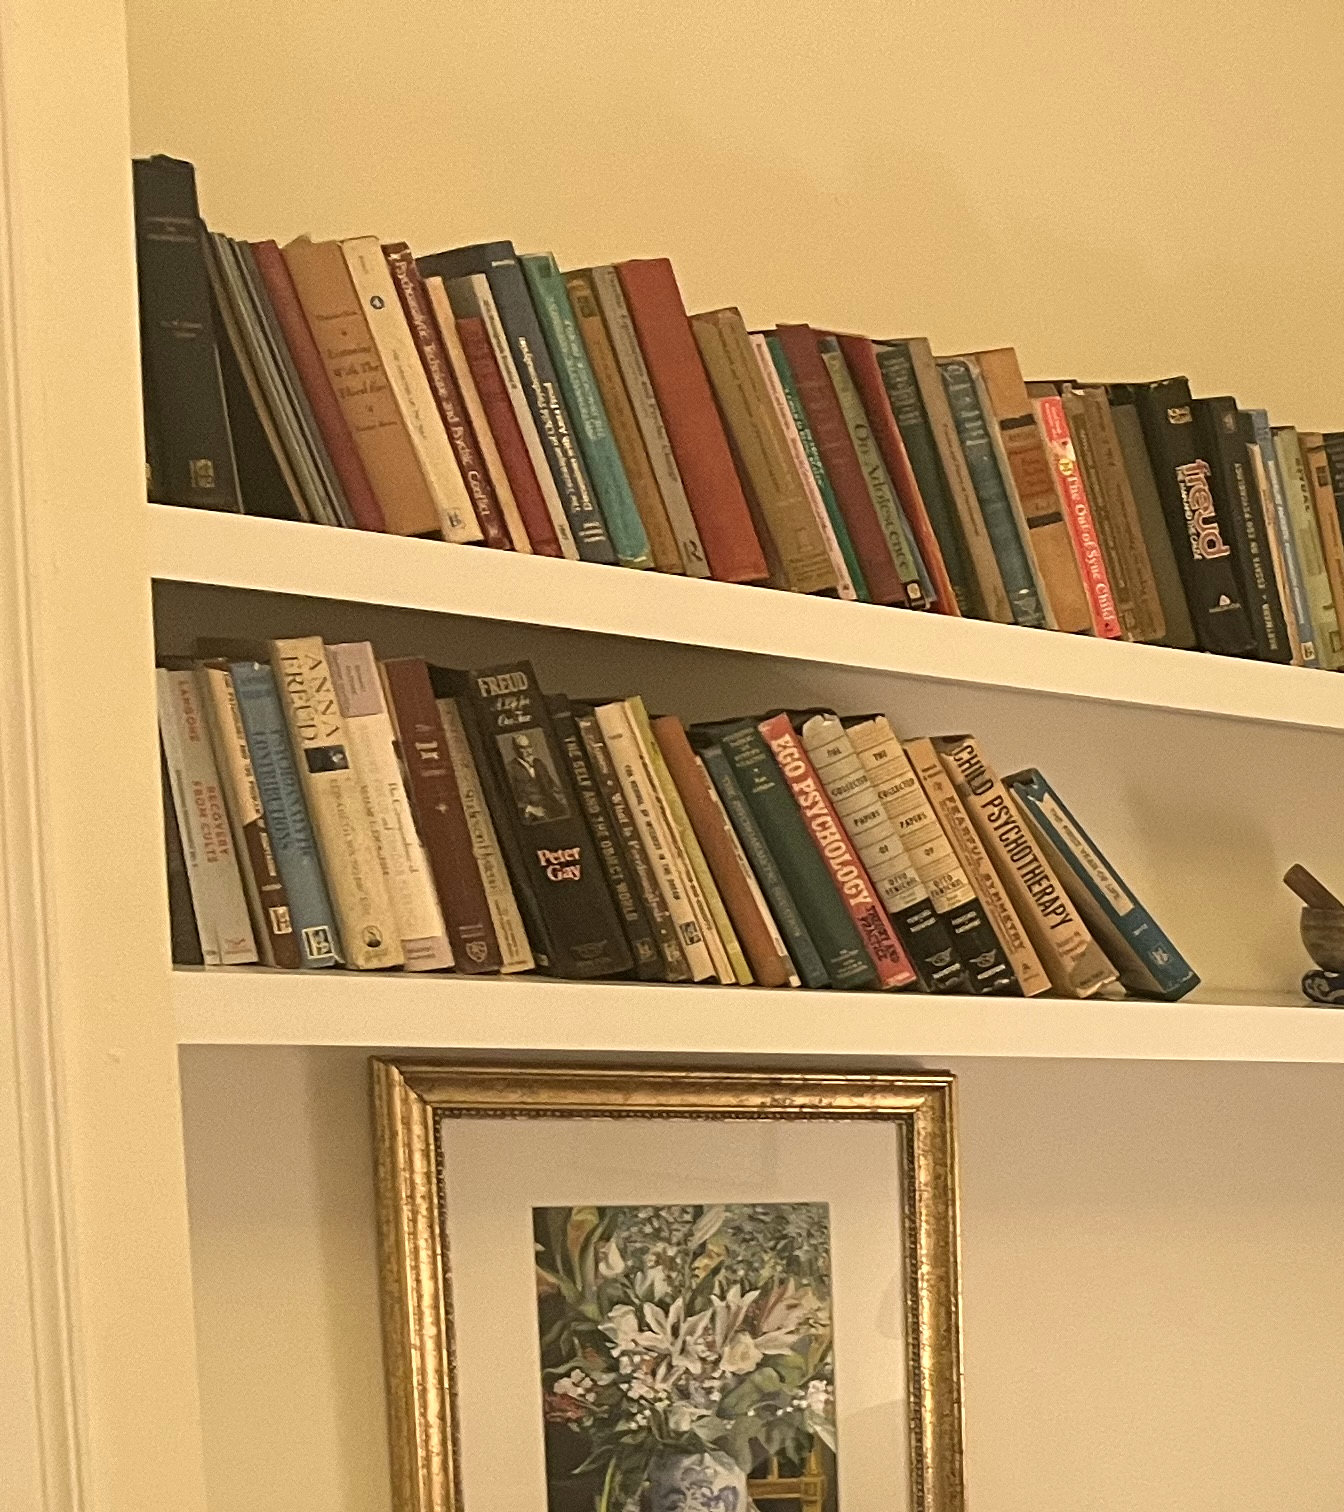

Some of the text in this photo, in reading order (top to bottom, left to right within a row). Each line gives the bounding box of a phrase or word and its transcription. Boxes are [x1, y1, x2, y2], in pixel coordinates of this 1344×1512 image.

[539, 407, 557, 435] Child
[542, 379, 560, 409] Freud
[551, 407, 569, 436] Anna
[442, 398, 460, 423] and
[465, 468, 492, 518] Conflict
[559, 434, 576, 459] with
[852, 422, 875, 456] On
[865, 461, 914, 573] Adolescence
[1176, 456, 1234, 562] freud
[1065, 475, 1082, 502] The
[1094, 581, 1115, 622] Child
[279, 651, 319, 743] FREUD
[305, 650, 341, 738] ANNA
[477, 671, 529, 698] FREUD
[189, 778, 220, 865] FROM CULTS
[205, 783, 230, 856] RECOVERY
[460, 787, 485, 832] Studies
[563, 733, 638, 923] THE SELF AND THE OBJECT WORLD
[608, 791, 630, 826] What
[719, 774, 737, 798] THE
[730, 798, 778, 886] PSYCHOANALYTIC
[768, 731, 809, 781] EGO
[789, 774, 873, 912] PSYCHOLOGY
[949, 741, 1074, 933] CHILD PSYCHOTHERAPY
[537, 846, 580, 867] Peter
[546, 864, 581, 882] Gay
[943, 793, 986, 868] FEARFUL
[979, 869, 1027, 953] SYMMETRY
[1046, 805, 1065, 826] THE
[1076, 846, 1099, 871] YEAR
[1093, 868, 1109, 885] OF
[1103, 881, 1122, 902] LIFE
[856, 912, 889, 963] PRACTICE
[864, 903, 902, 965] THEORY AND
